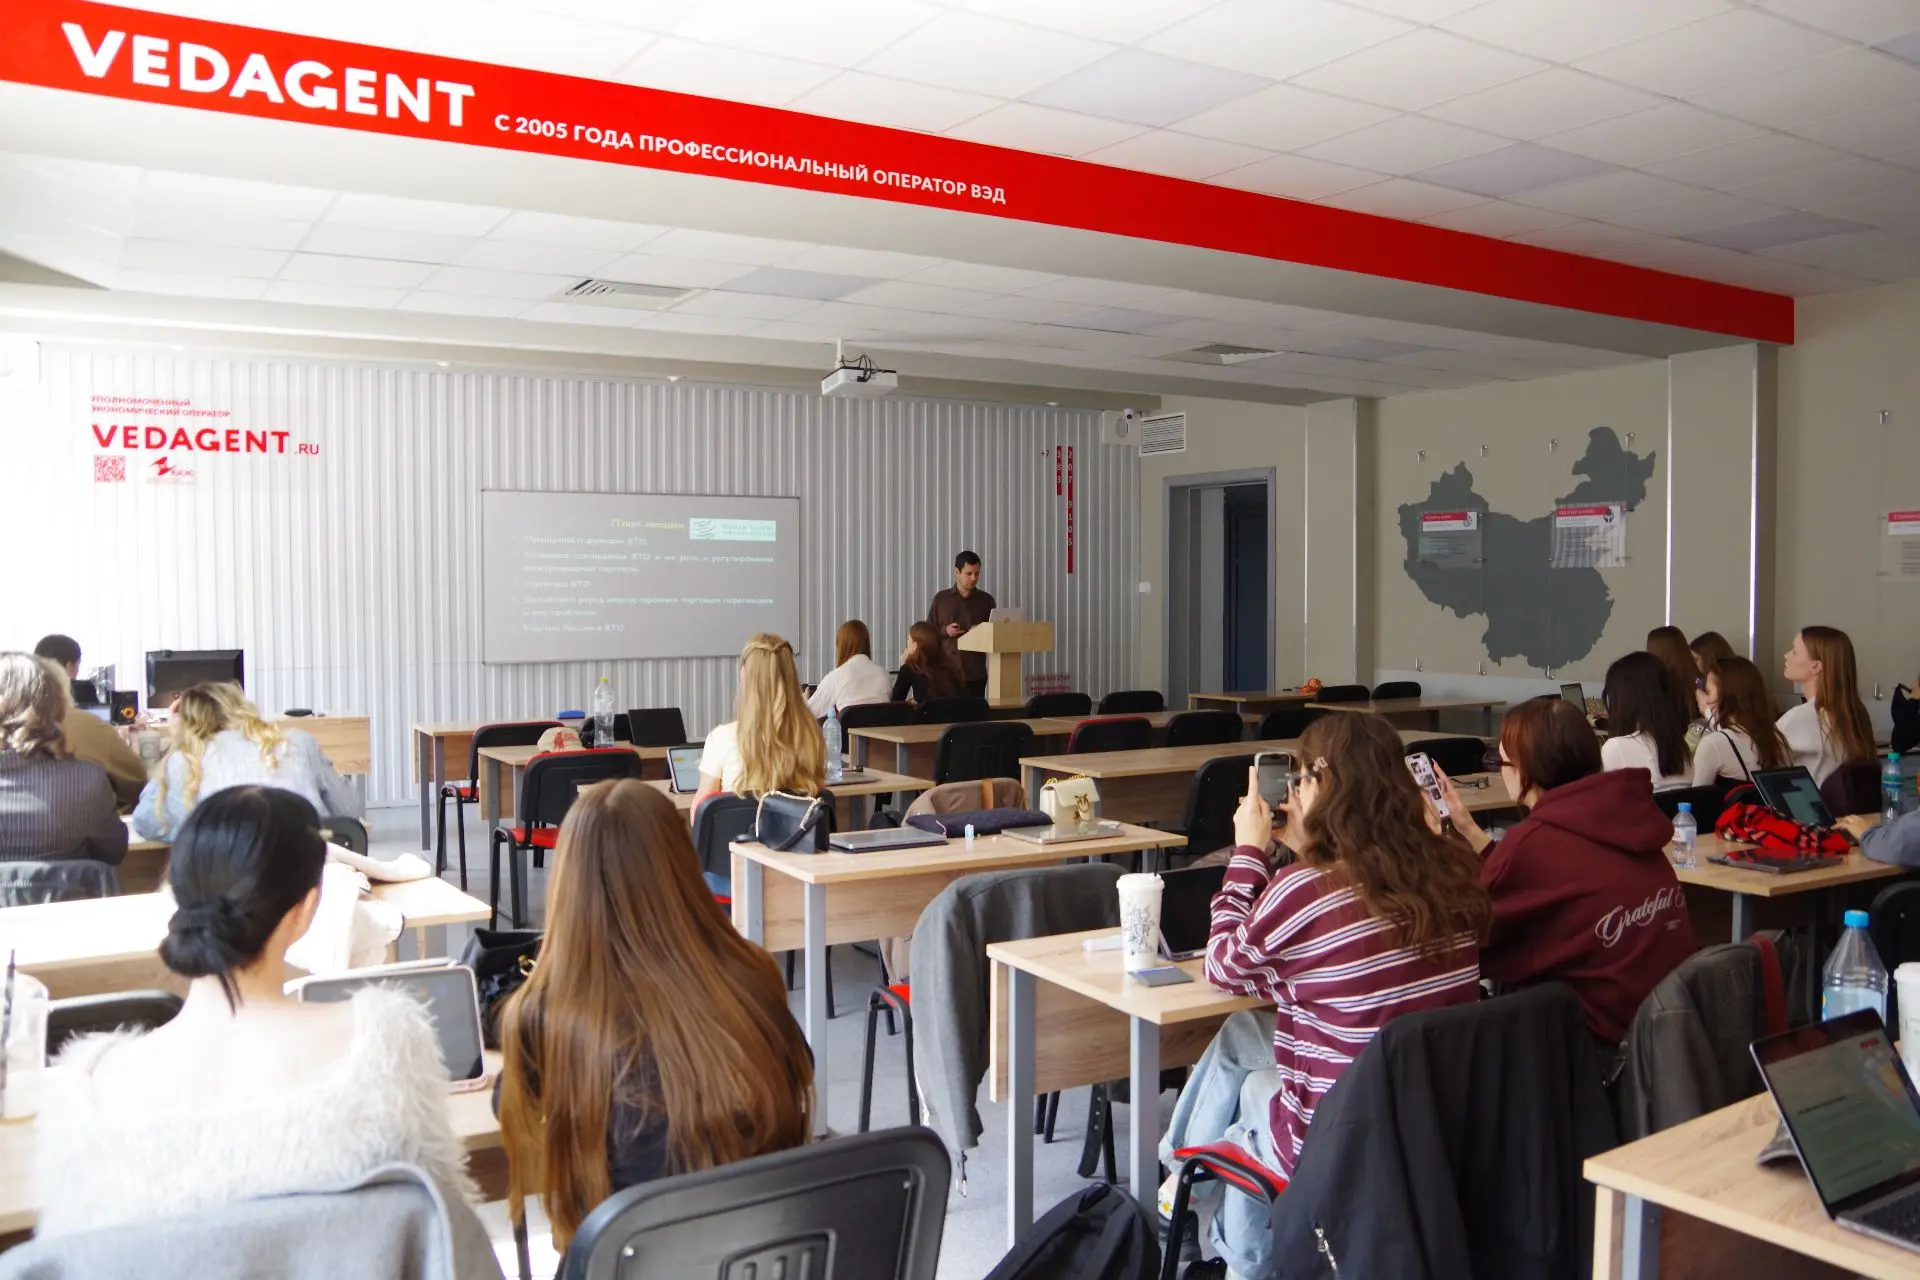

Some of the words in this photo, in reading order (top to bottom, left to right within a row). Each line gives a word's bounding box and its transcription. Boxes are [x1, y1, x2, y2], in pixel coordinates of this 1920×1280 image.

[61, 22, 476, 127] VEDAGENT
[494, 114, 510, 132] С
[515, 116, 568, 140] 2005
[573, 123, 634, 151] ГОДА
[639, 133, 869, 183] ПРОФЕССИОНАЛЬНЫЙ
[873, 168, 967, 197] ОПЕРАТОР
[971, 182, 1006, 204] ВЭД
[1595, 887, 1674, 948] Grateful
